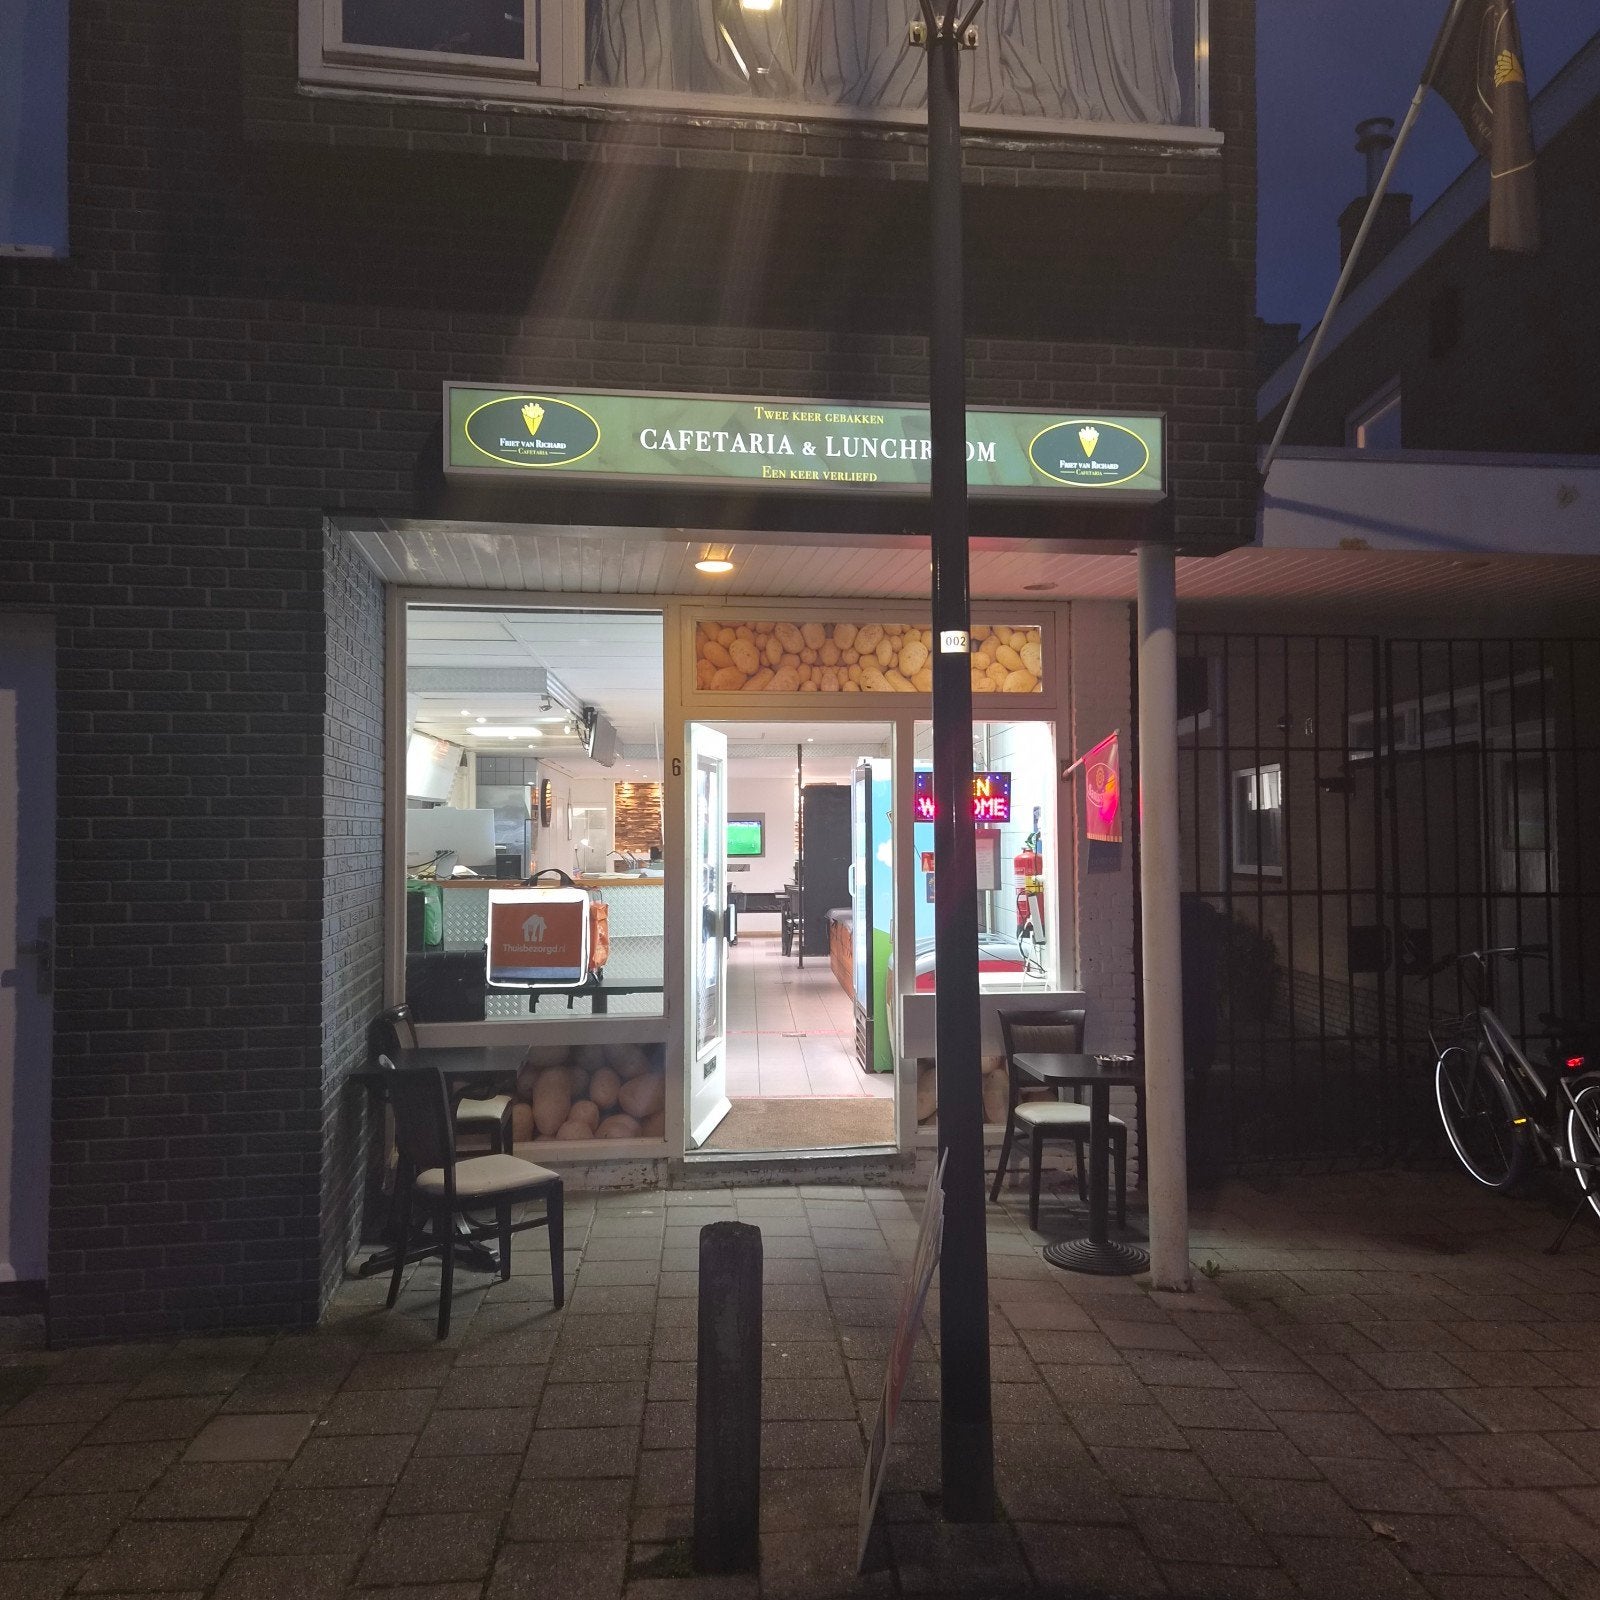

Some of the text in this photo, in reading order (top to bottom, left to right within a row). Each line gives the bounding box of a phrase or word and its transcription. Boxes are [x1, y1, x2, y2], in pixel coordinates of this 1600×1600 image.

[639, 428, 795, 455] CAFETARIA
[801, 441, 817, 456] &
[762, 465, 786, 479] EEN
[790, 469, 819, 480] KEER
[945, 636, 966, 647] 002
[672, 757, 682, 777] 6
[503, 943, 567, 955] Thuisbezorgd.nl
